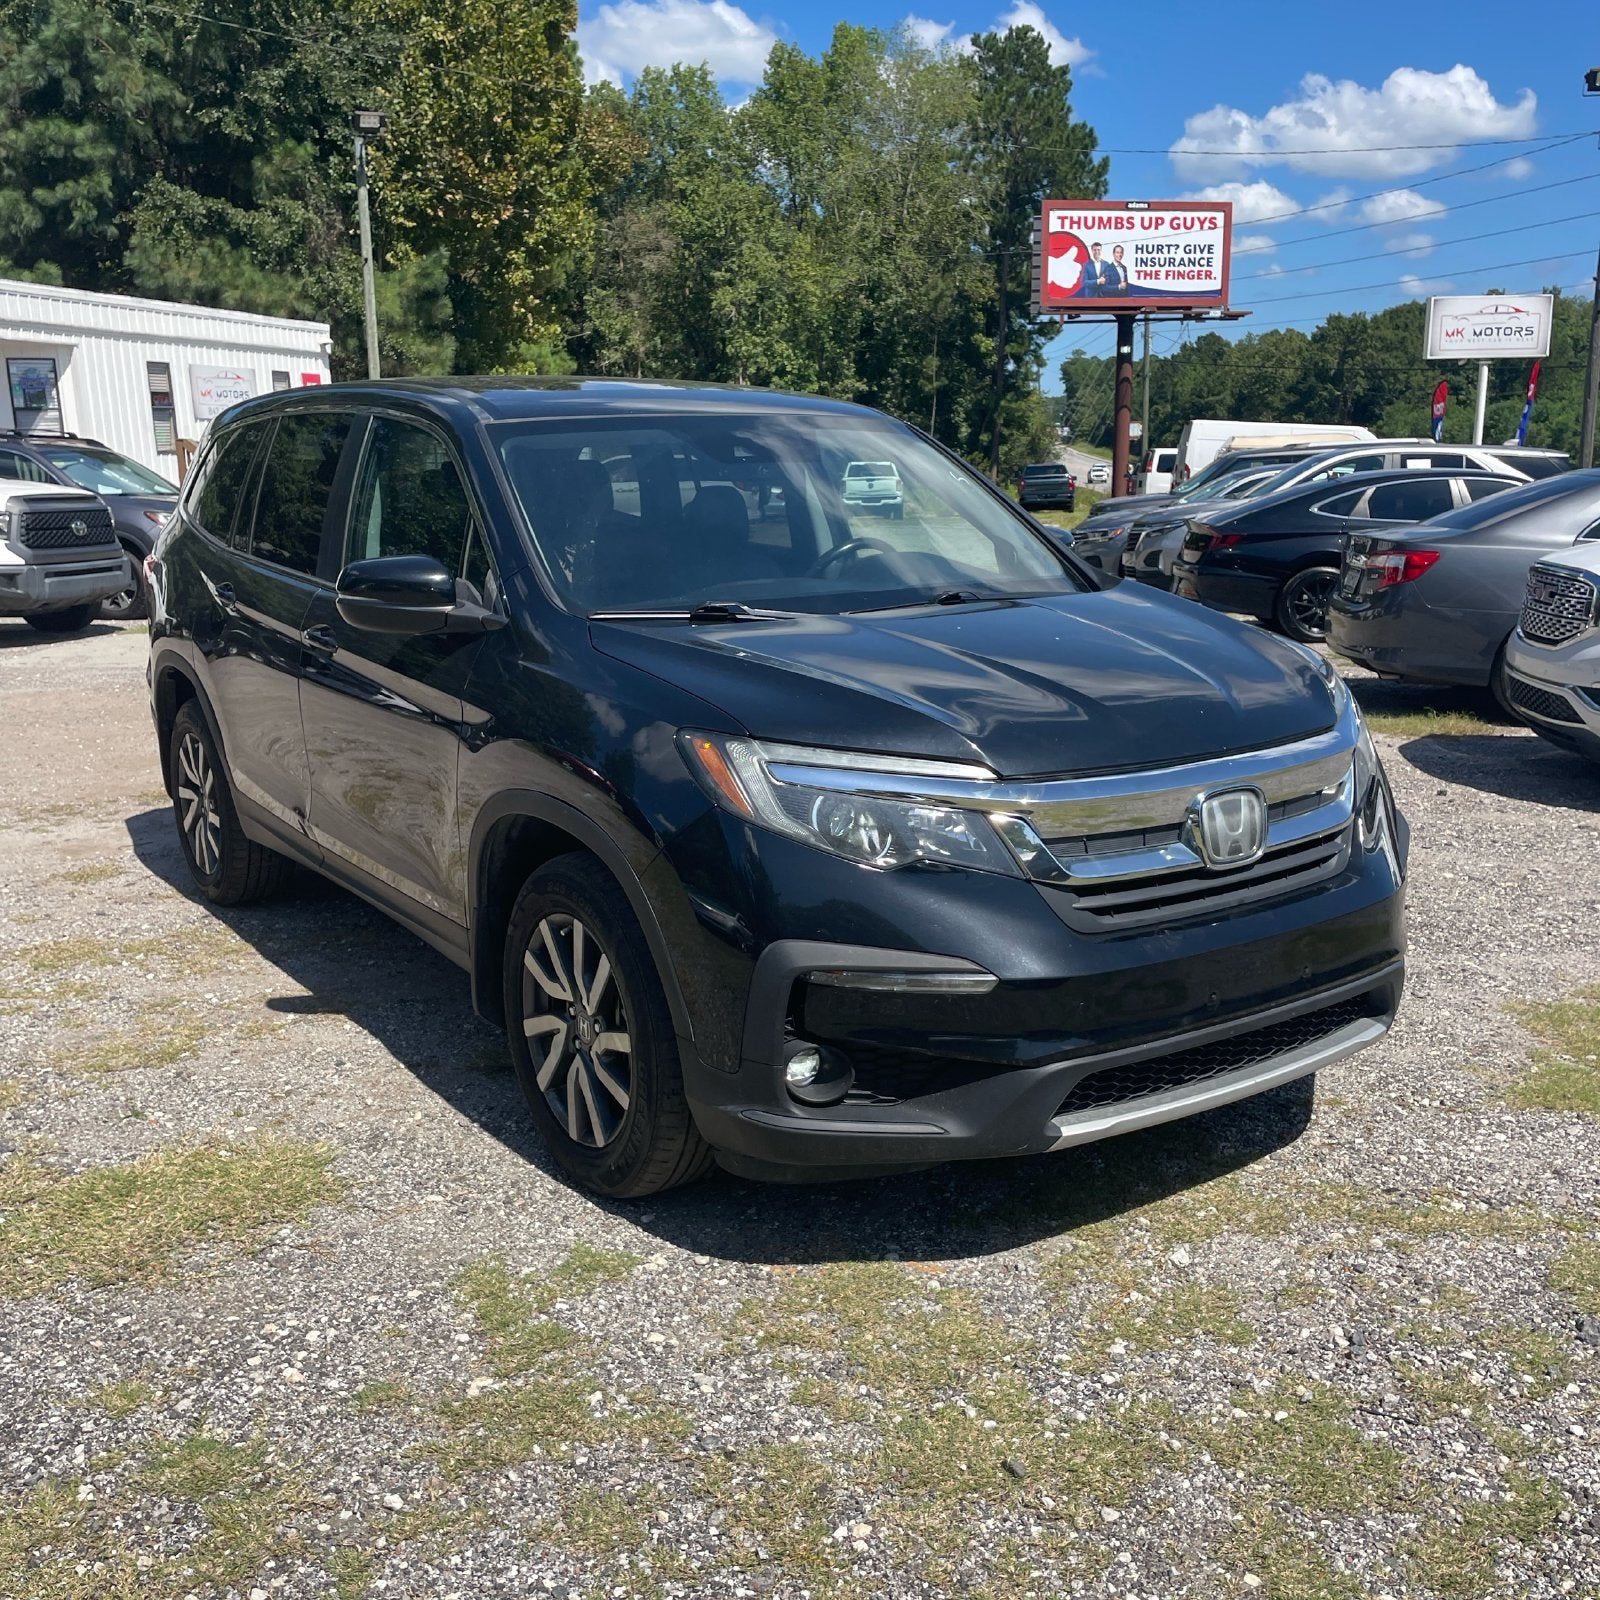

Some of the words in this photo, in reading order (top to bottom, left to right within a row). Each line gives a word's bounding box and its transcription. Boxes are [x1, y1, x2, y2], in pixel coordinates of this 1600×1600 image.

[1057, 216, 1135, 231] THUMBS
[1140, 216, 1165, 231] UP
[1169, 216, 1218, 231] GUYS
[1135, 243, 1180, 255] HURT?
[1183, 243, 1215, 255] GIVE
[1135, 256, 1214, 268] INSURANCE
[1135, 269, 1161, 280] THE
[1165, 269, 1217, 280] FINGER.
[1445, 328, 1465, 338] MK
[1472, 326, 1534, 338] MOTORS
[216, 389, 250, 400] MOTORS
